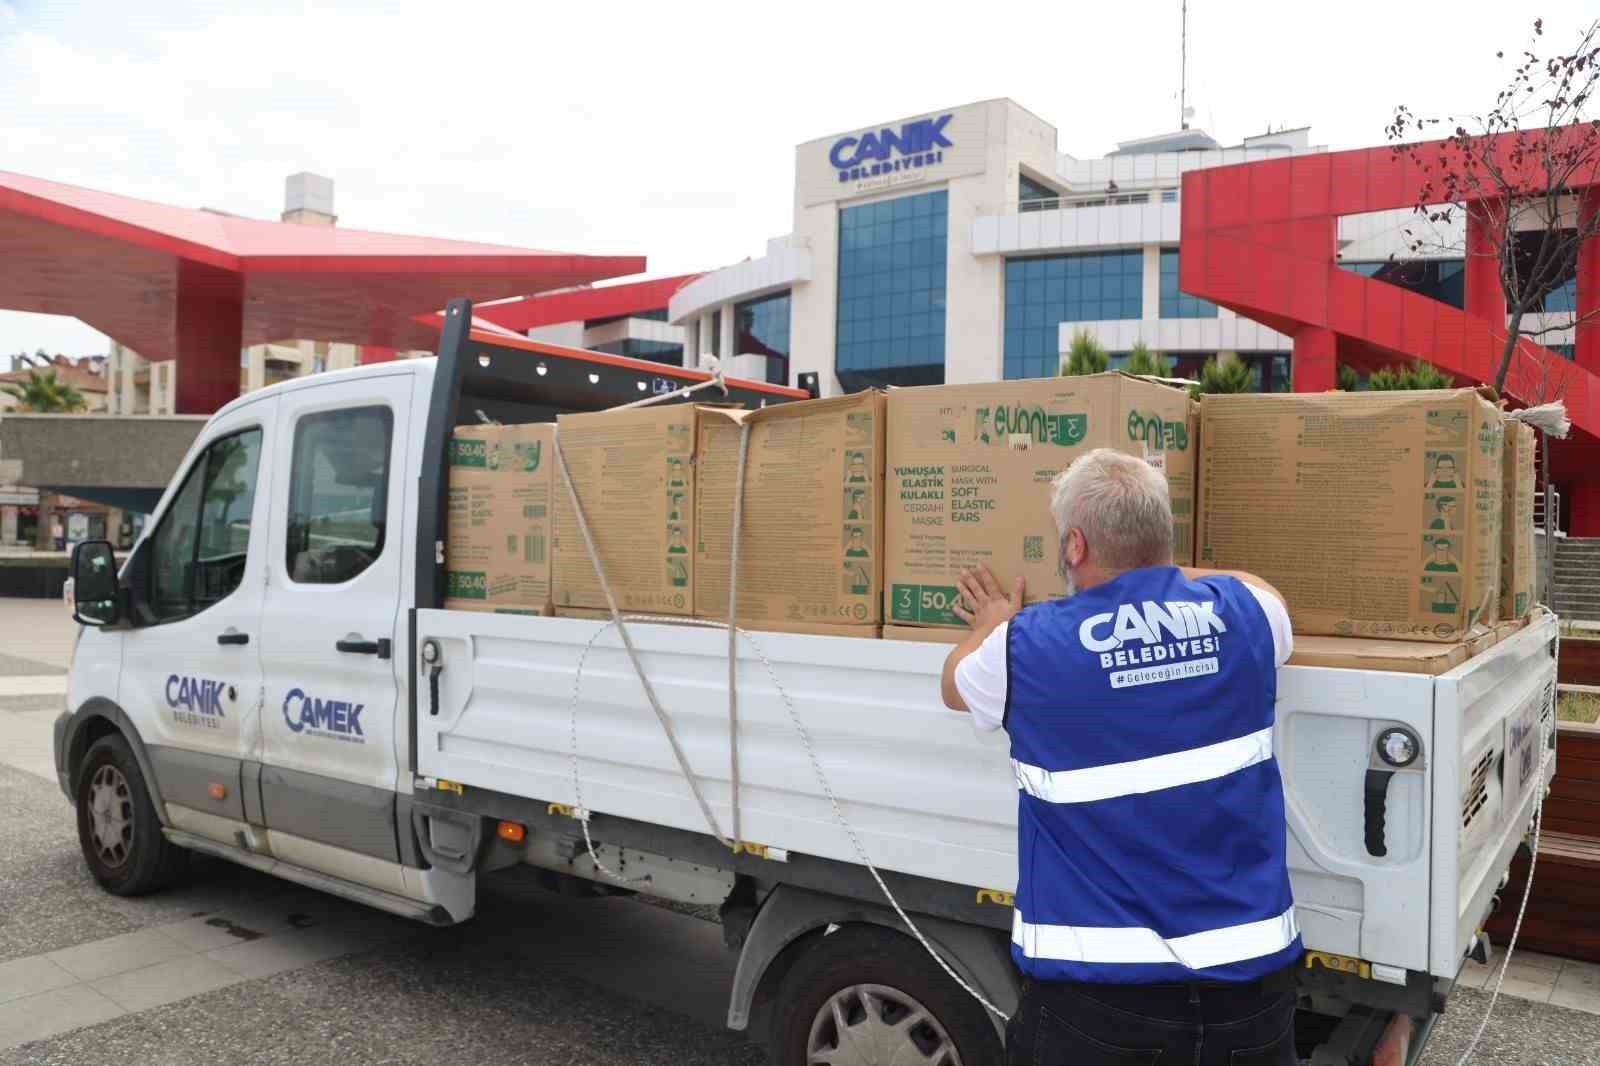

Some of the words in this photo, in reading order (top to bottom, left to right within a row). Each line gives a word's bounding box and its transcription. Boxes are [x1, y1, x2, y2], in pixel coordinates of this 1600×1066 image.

[975, 476, 998, 485] WITH
[951, 487, 978, 497] SOFT
[951, 499, 996, 510] ELASTIC
[951, 512, 981, 522] EARS
[899, 588, 912, 609] 3
[283, 688, 365, 736] CAMEK
